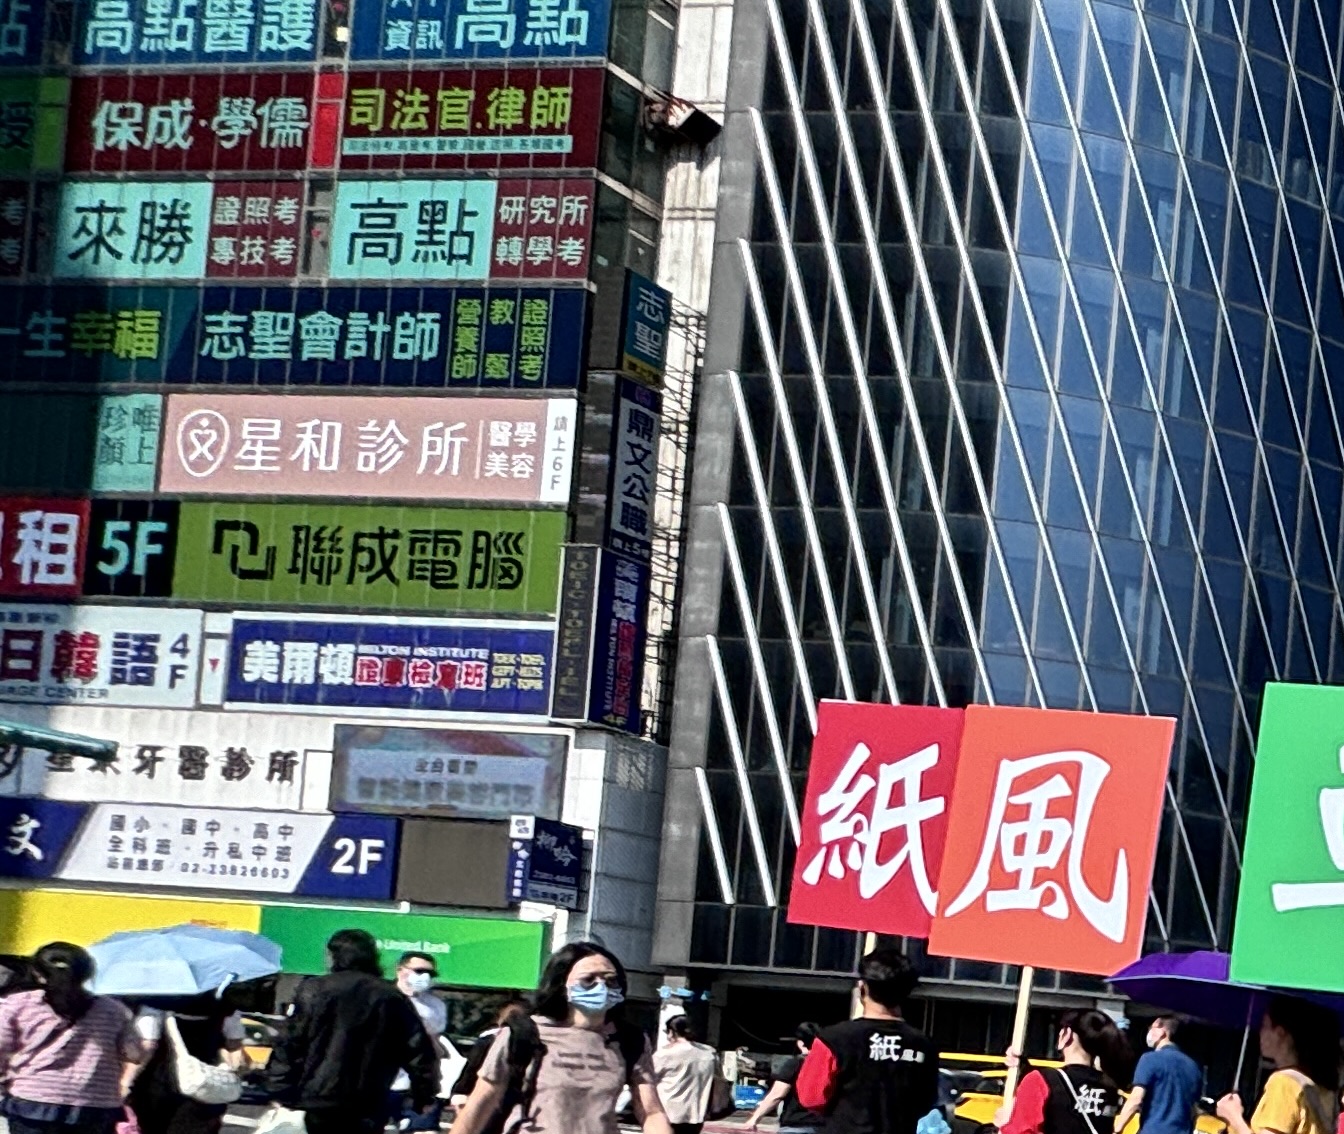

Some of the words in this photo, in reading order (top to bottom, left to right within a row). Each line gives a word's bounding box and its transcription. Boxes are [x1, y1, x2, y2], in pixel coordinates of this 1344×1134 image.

[68, 198, 194, 265] 來勝
[214, 196, 299, 226] 證照考
[347, 197, 479, 266] 高點
[499, 195, 589, 226] 研究所
[211, 236, 297, 266] 專技考
[496, 236, 585, 266] 轉學考
[201, 310, 440, 361] 志聖會計師
[632, 286, 665, 361] 志聖
[233, 417, 471, 476] 星和診所
[488, 420, 537, 449] 醫學
[484, 450, 535, 479] 美容
[619, 407, 655, 536] 鼎文公職
[97, 520, 168, 575] 5F
[289, 526, 526, 591] 聯成電腦
[331, 838, 385, 875] 2F
[803, 742, 944, 917] 紙
[945, 751, 1128, 942] 風
